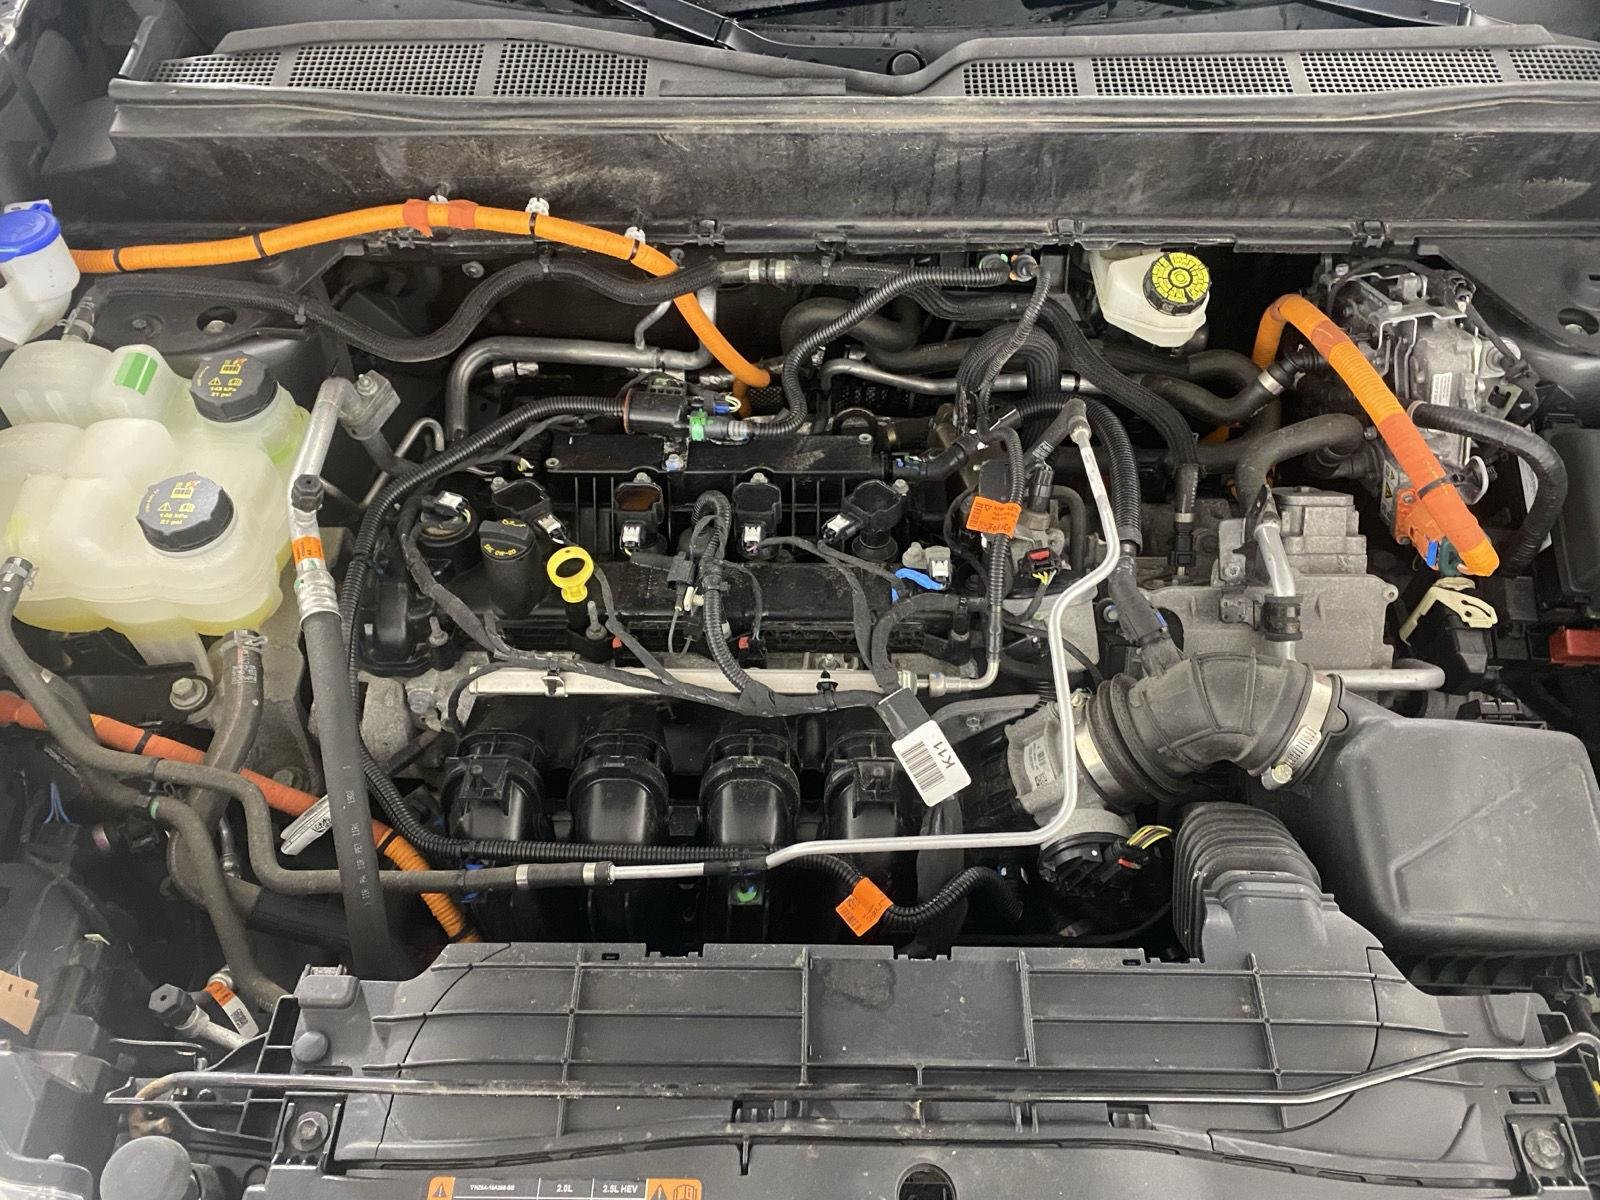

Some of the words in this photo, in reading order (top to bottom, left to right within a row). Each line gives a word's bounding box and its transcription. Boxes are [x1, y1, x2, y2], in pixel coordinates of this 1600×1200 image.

[933, 741, 956, 769] K11
[556, 1184, 573, 1193] 2.0L
[602, 1184, 619, 1193] 2.5L
[620, 1184, 638, 1193] HEV
